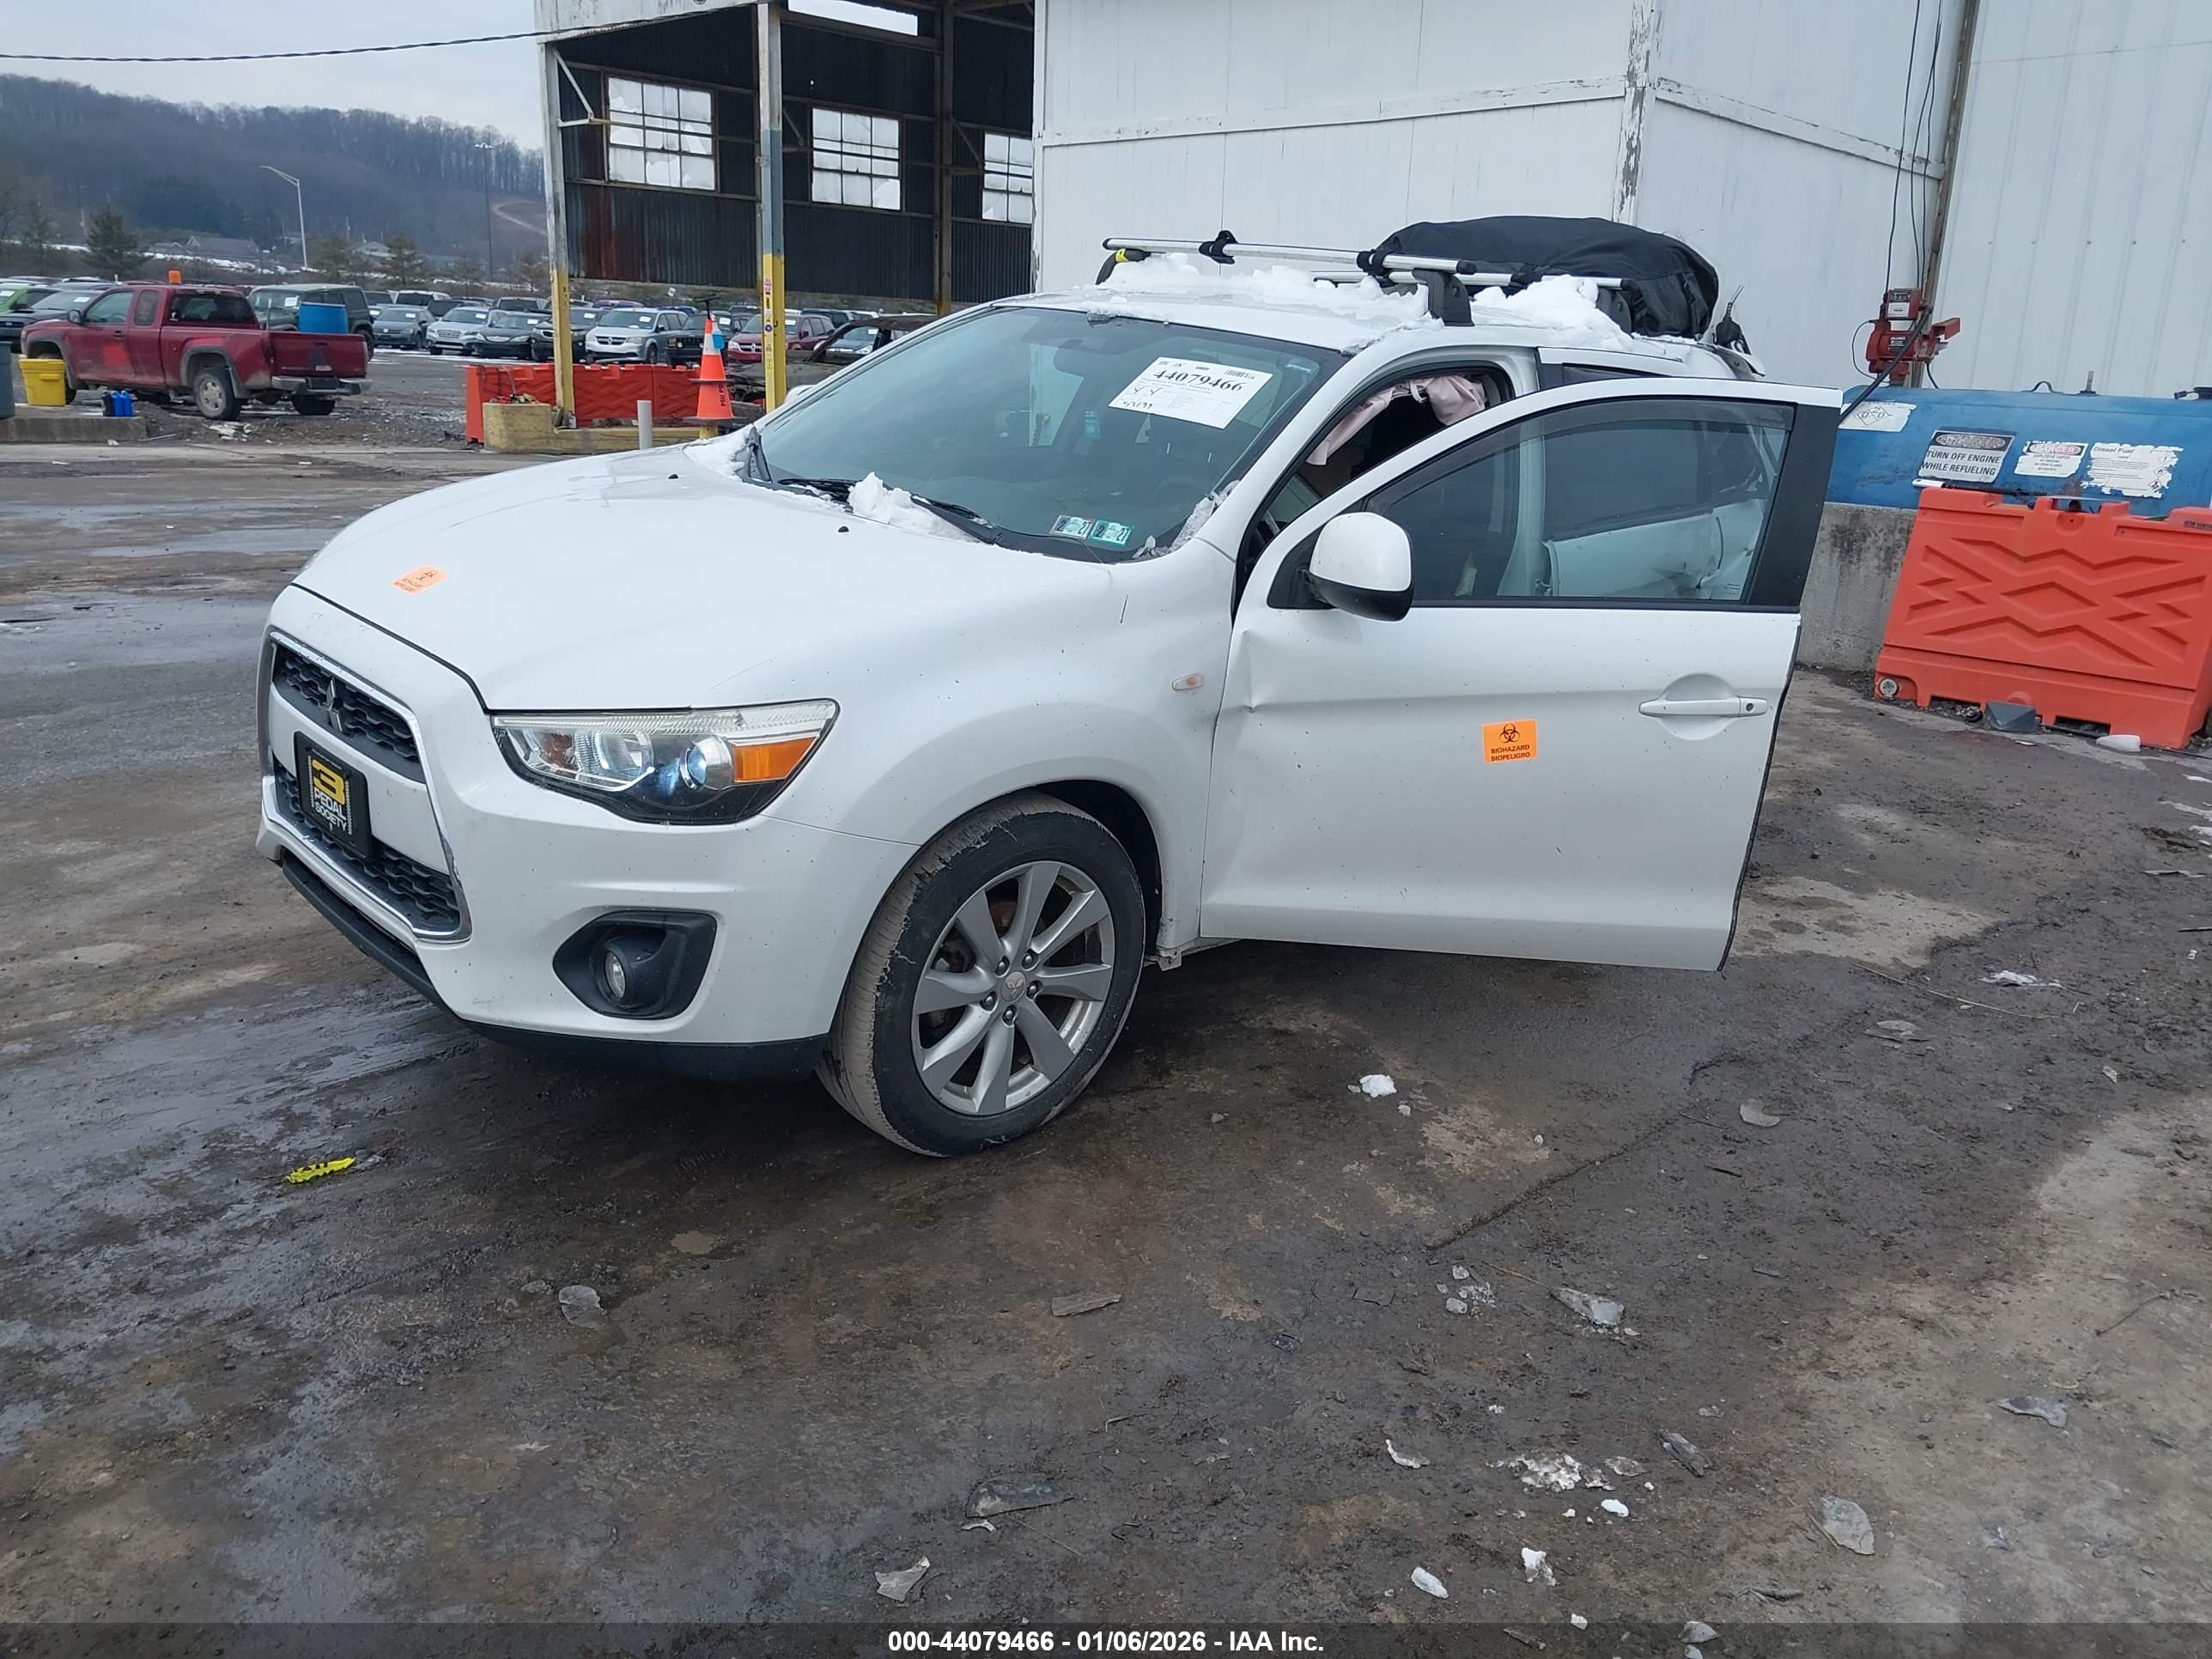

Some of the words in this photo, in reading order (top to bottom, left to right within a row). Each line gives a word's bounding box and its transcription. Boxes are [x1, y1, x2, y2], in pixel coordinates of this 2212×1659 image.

[1154, 370, 1247, 391] 44079466
[1927, 450, 1950, 460] TURN
[1950, 453, 1967, 462] OFF
[1966, 454, 2002, 465] ENGINE
[1922, 461, 1948, 471] WHILE
[1948, 465, 1996, 476] REFUELING
[1491, 744, 1530, 754] BIOHAZARD
[1491, 752, 1531, 762] BIOPELIGRO
[312, 759, 345, 805] 3
[313, 787, 347, 821] PEDAL
[314, 801, 347, 832] SOCIETY
